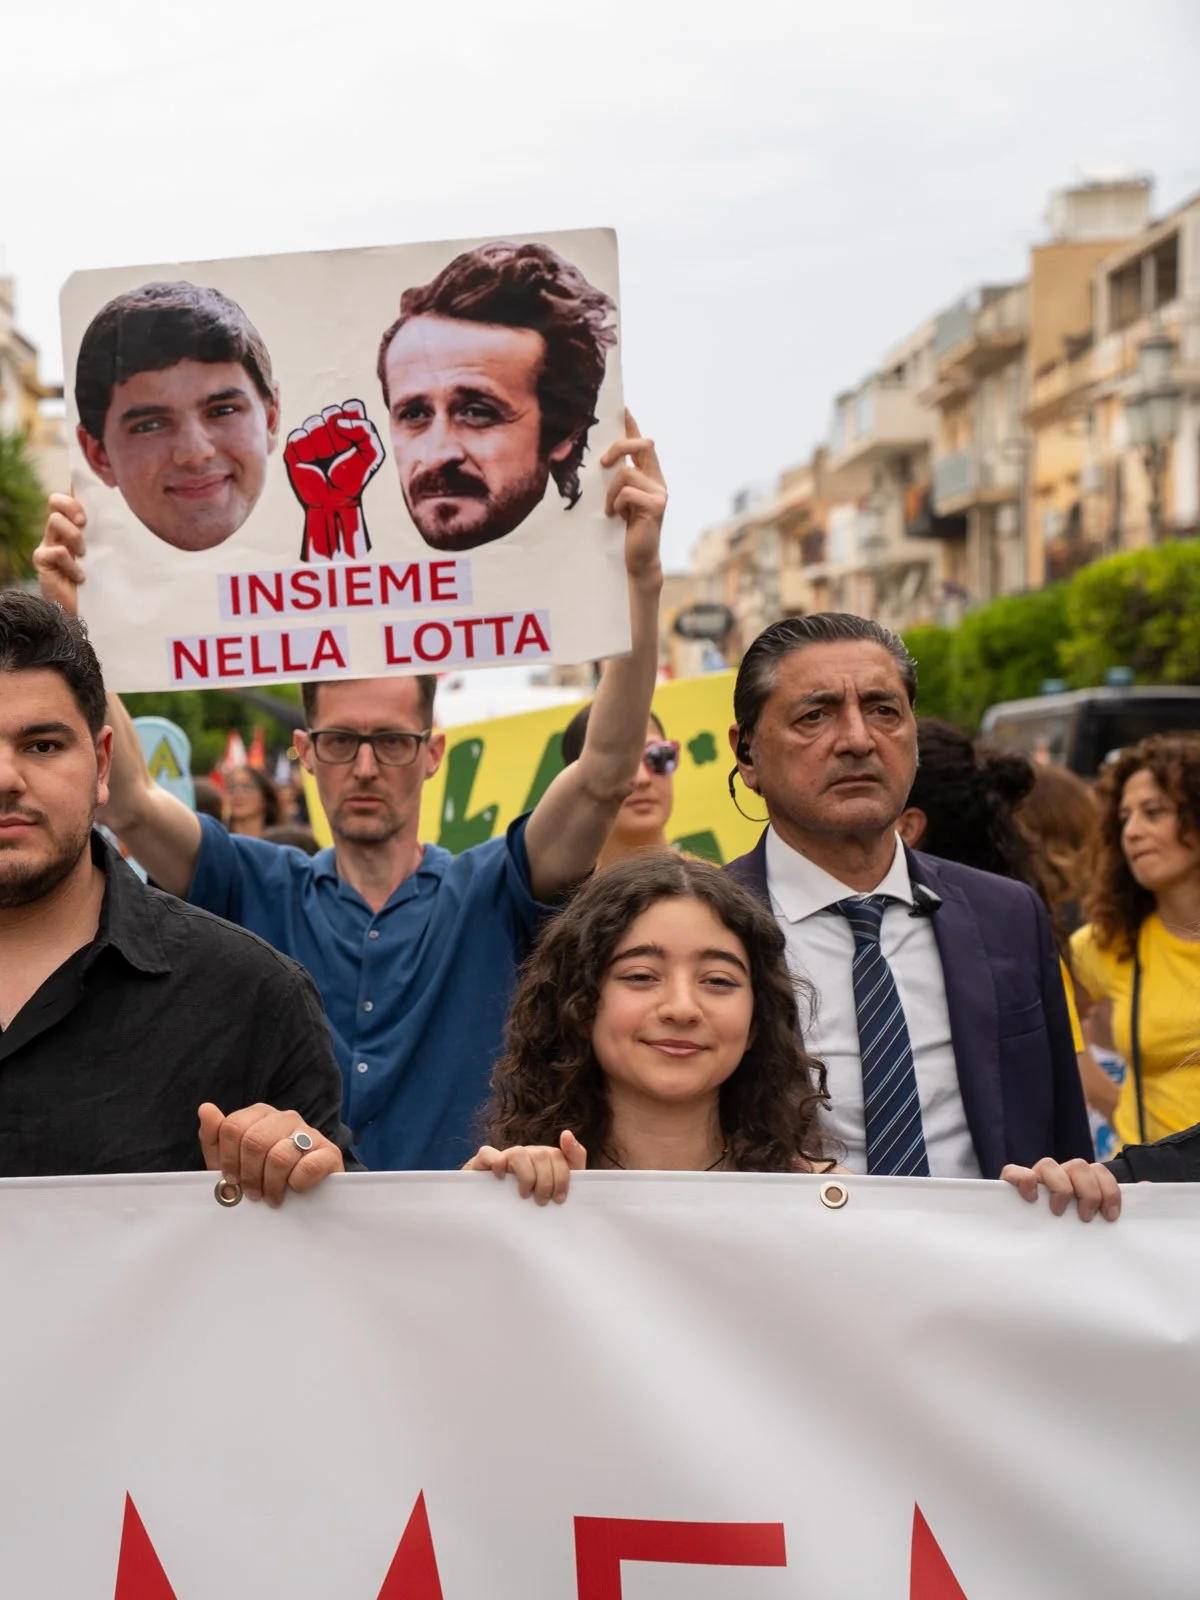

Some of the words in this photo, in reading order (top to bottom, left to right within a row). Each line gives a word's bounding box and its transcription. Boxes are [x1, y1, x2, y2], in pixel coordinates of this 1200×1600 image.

[230, 560, 459, 615] INSIEME
[172, 629, 347, 680] NELLA
[383, 613, 550, 665] LOTTA
